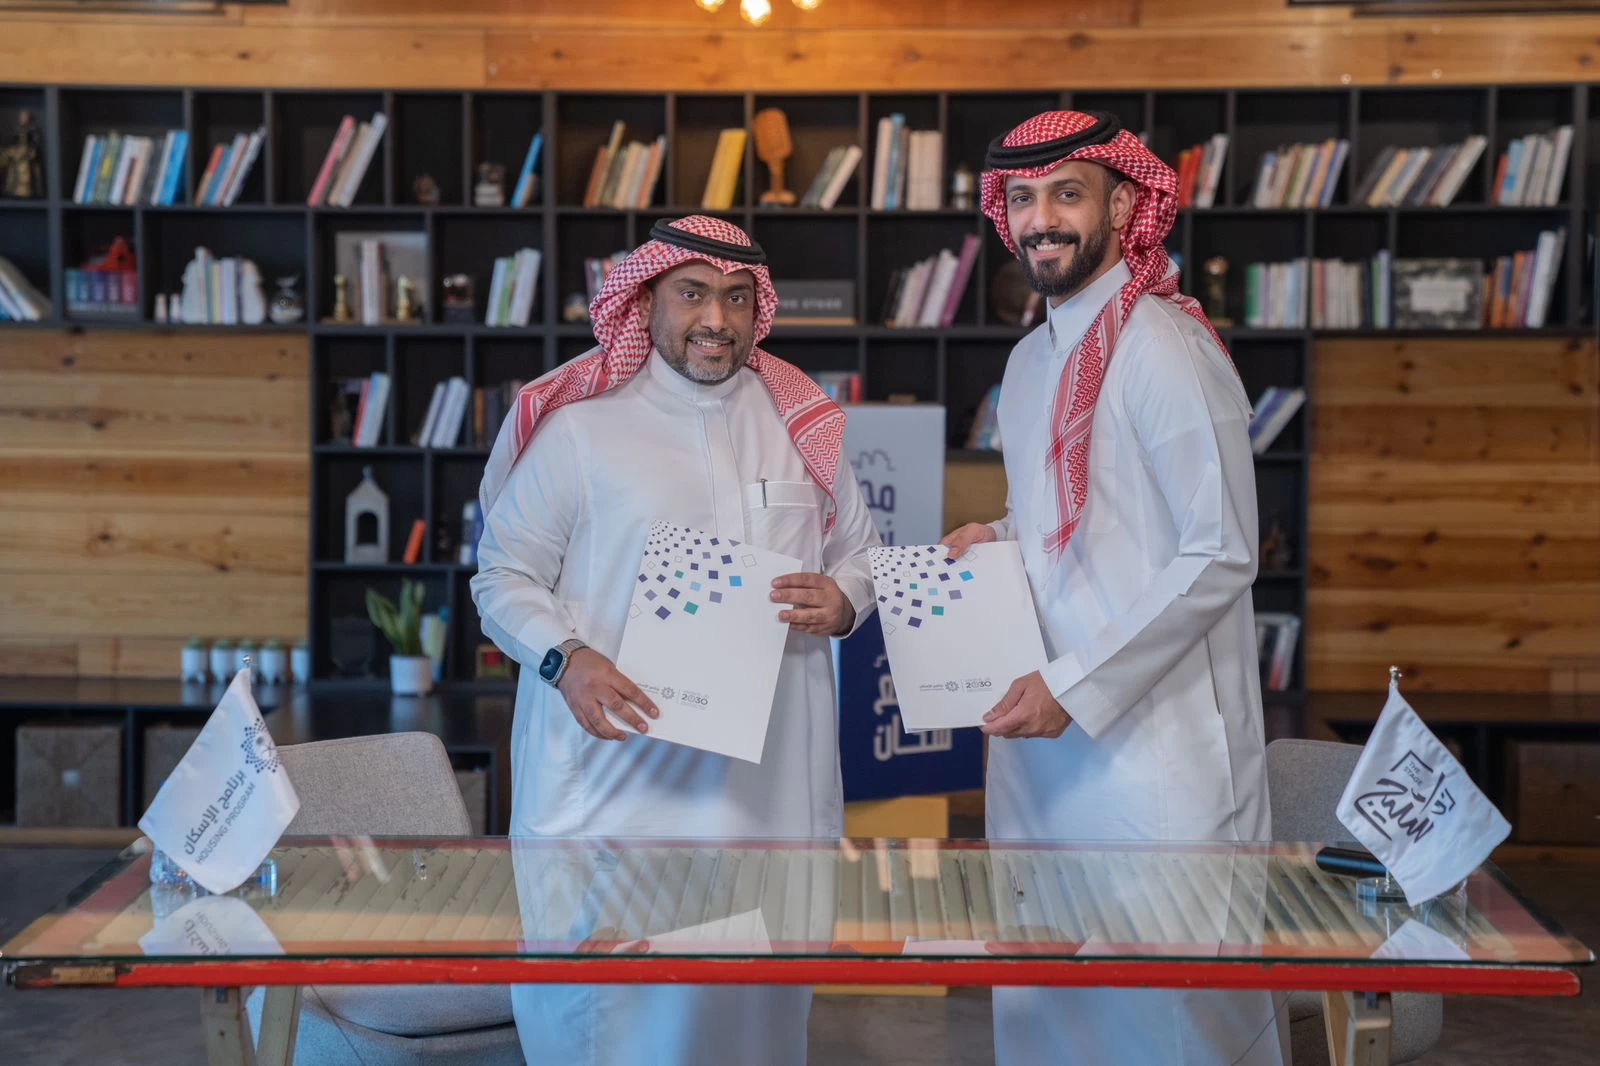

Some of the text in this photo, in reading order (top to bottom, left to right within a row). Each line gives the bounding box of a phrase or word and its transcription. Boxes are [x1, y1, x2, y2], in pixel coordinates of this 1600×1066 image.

[1403, 767, 1424, 787] STAGE
[1408, 760, 1421, 775] THE
[217, 769, 247, 811] برنامج
[194, 782, 257, 865] HOUSING PROGRAM
